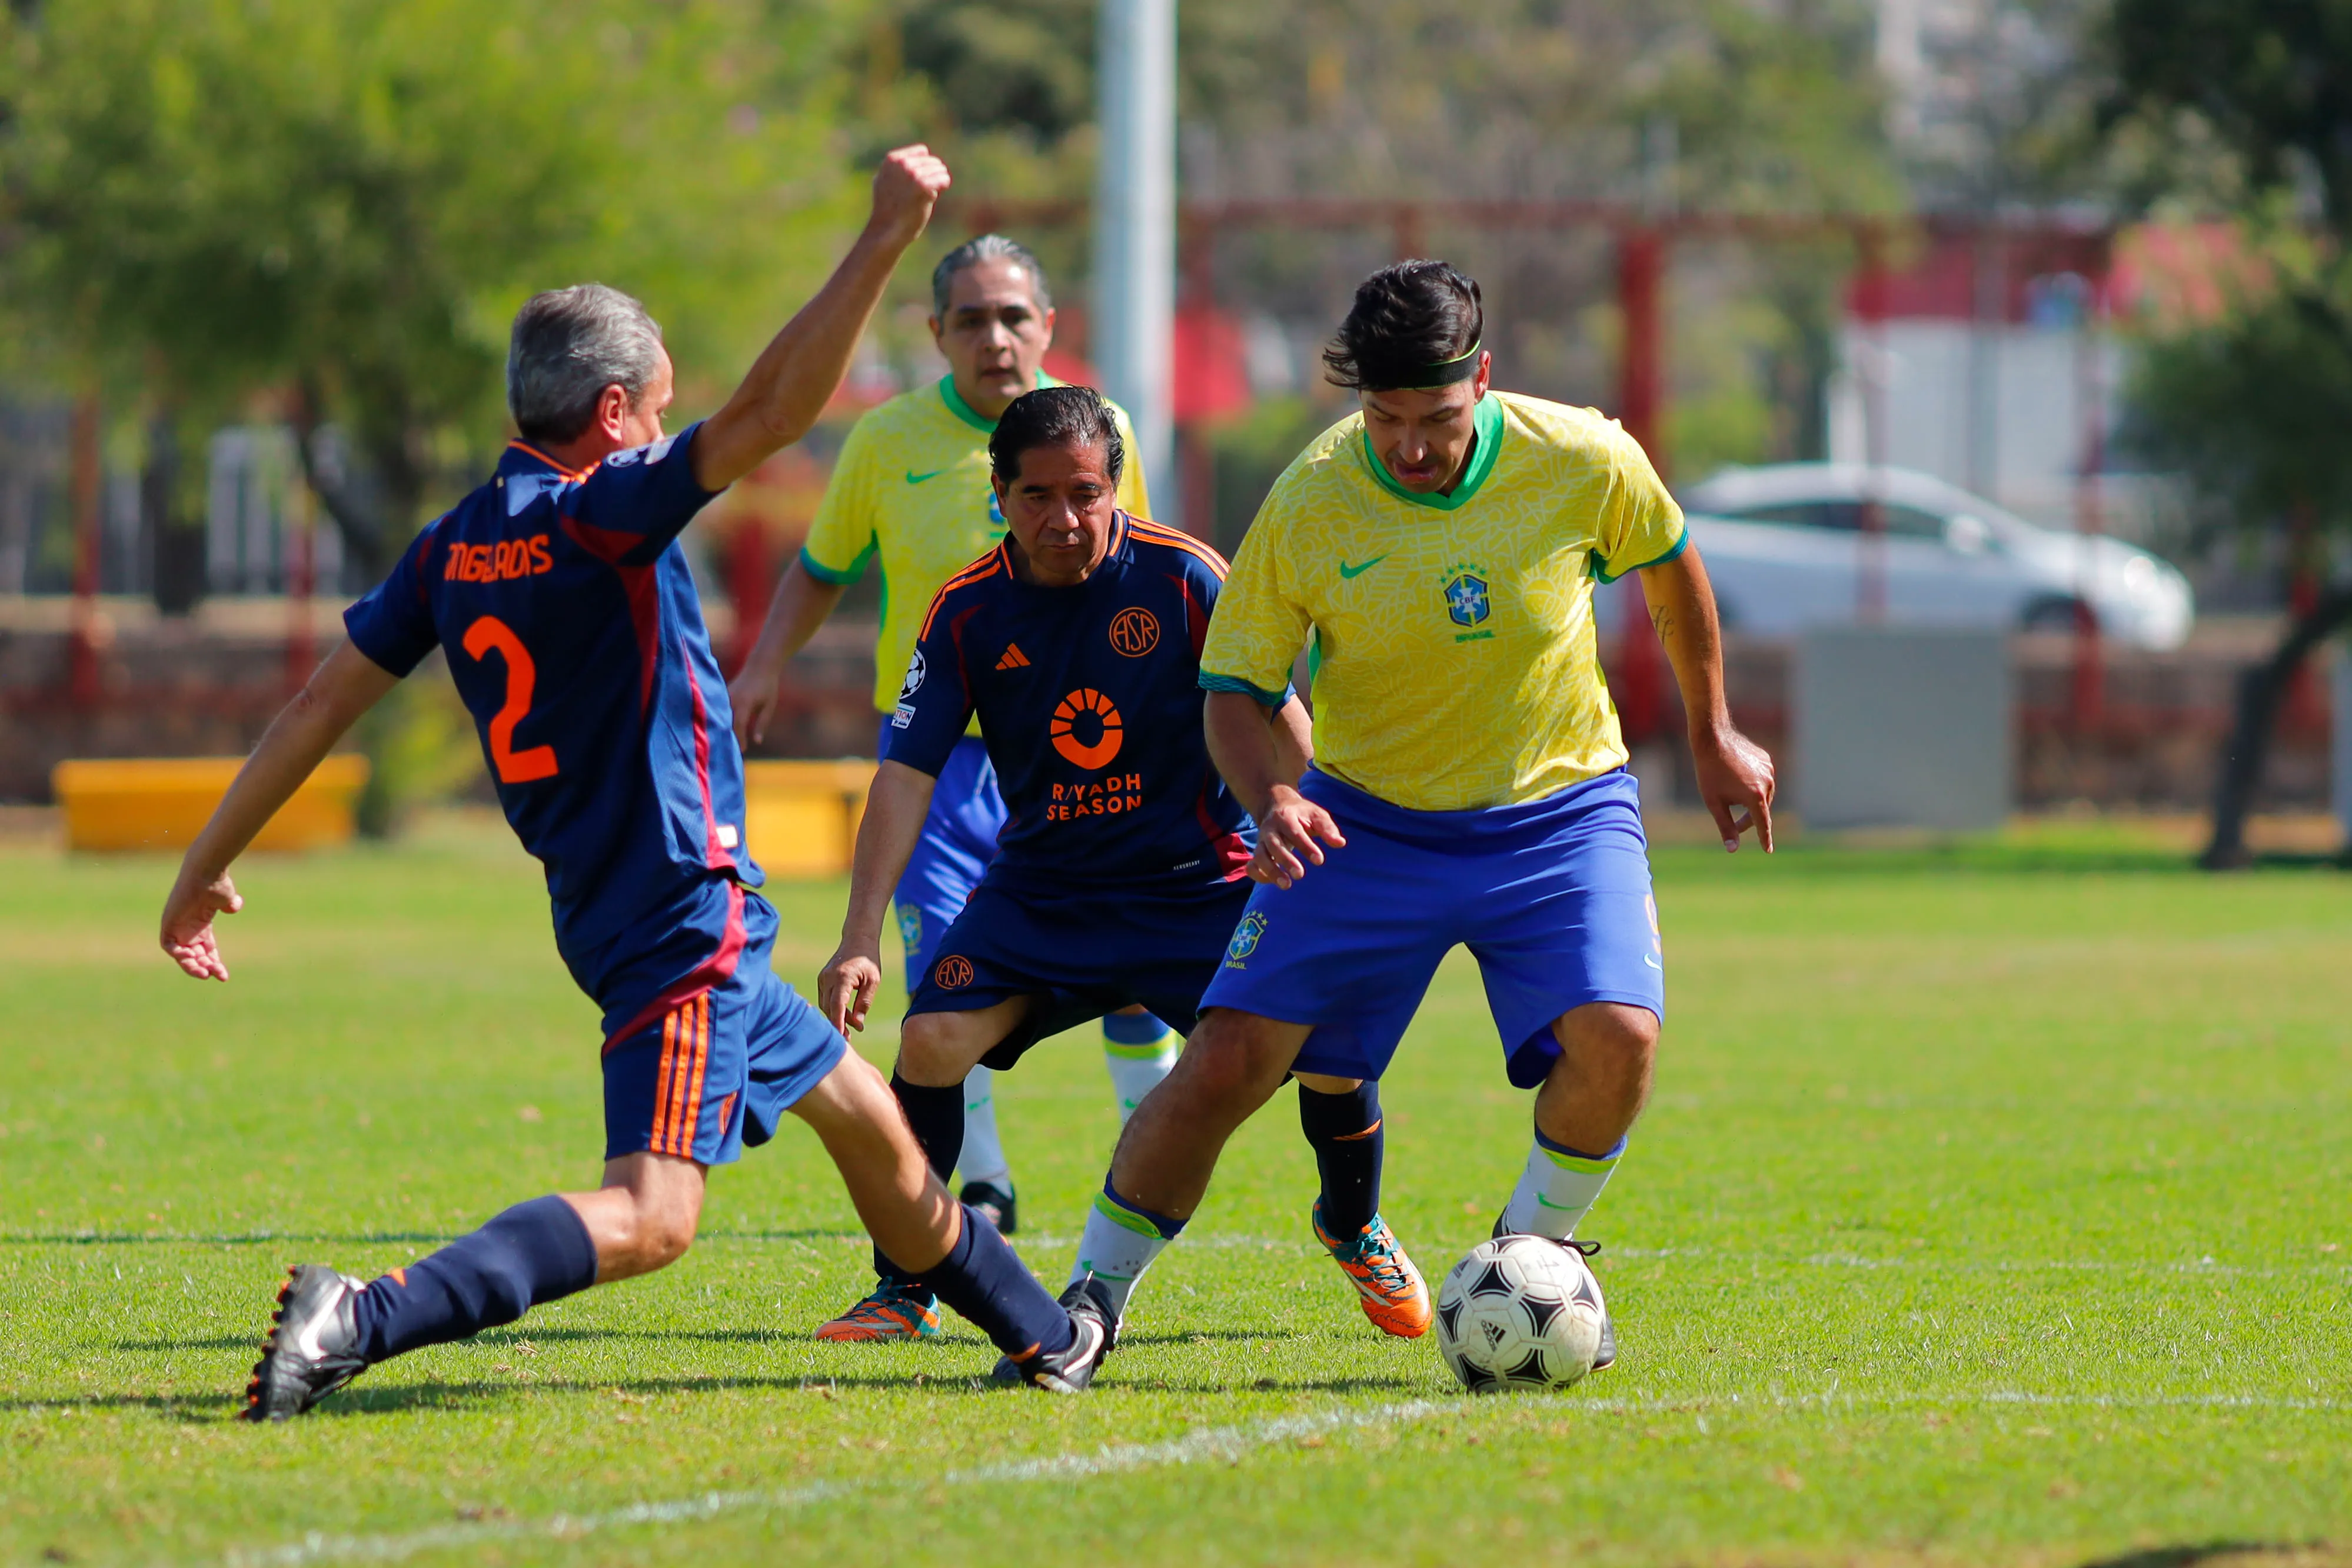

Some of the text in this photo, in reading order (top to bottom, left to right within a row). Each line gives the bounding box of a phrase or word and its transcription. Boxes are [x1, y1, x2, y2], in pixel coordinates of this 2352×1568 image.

[1113, 612, 1155, 651] ASR
[463, 615, 558, 784] 2
[1047, 795, 1141, 821] SEASON
[938, 959, 970, 987] ASR
